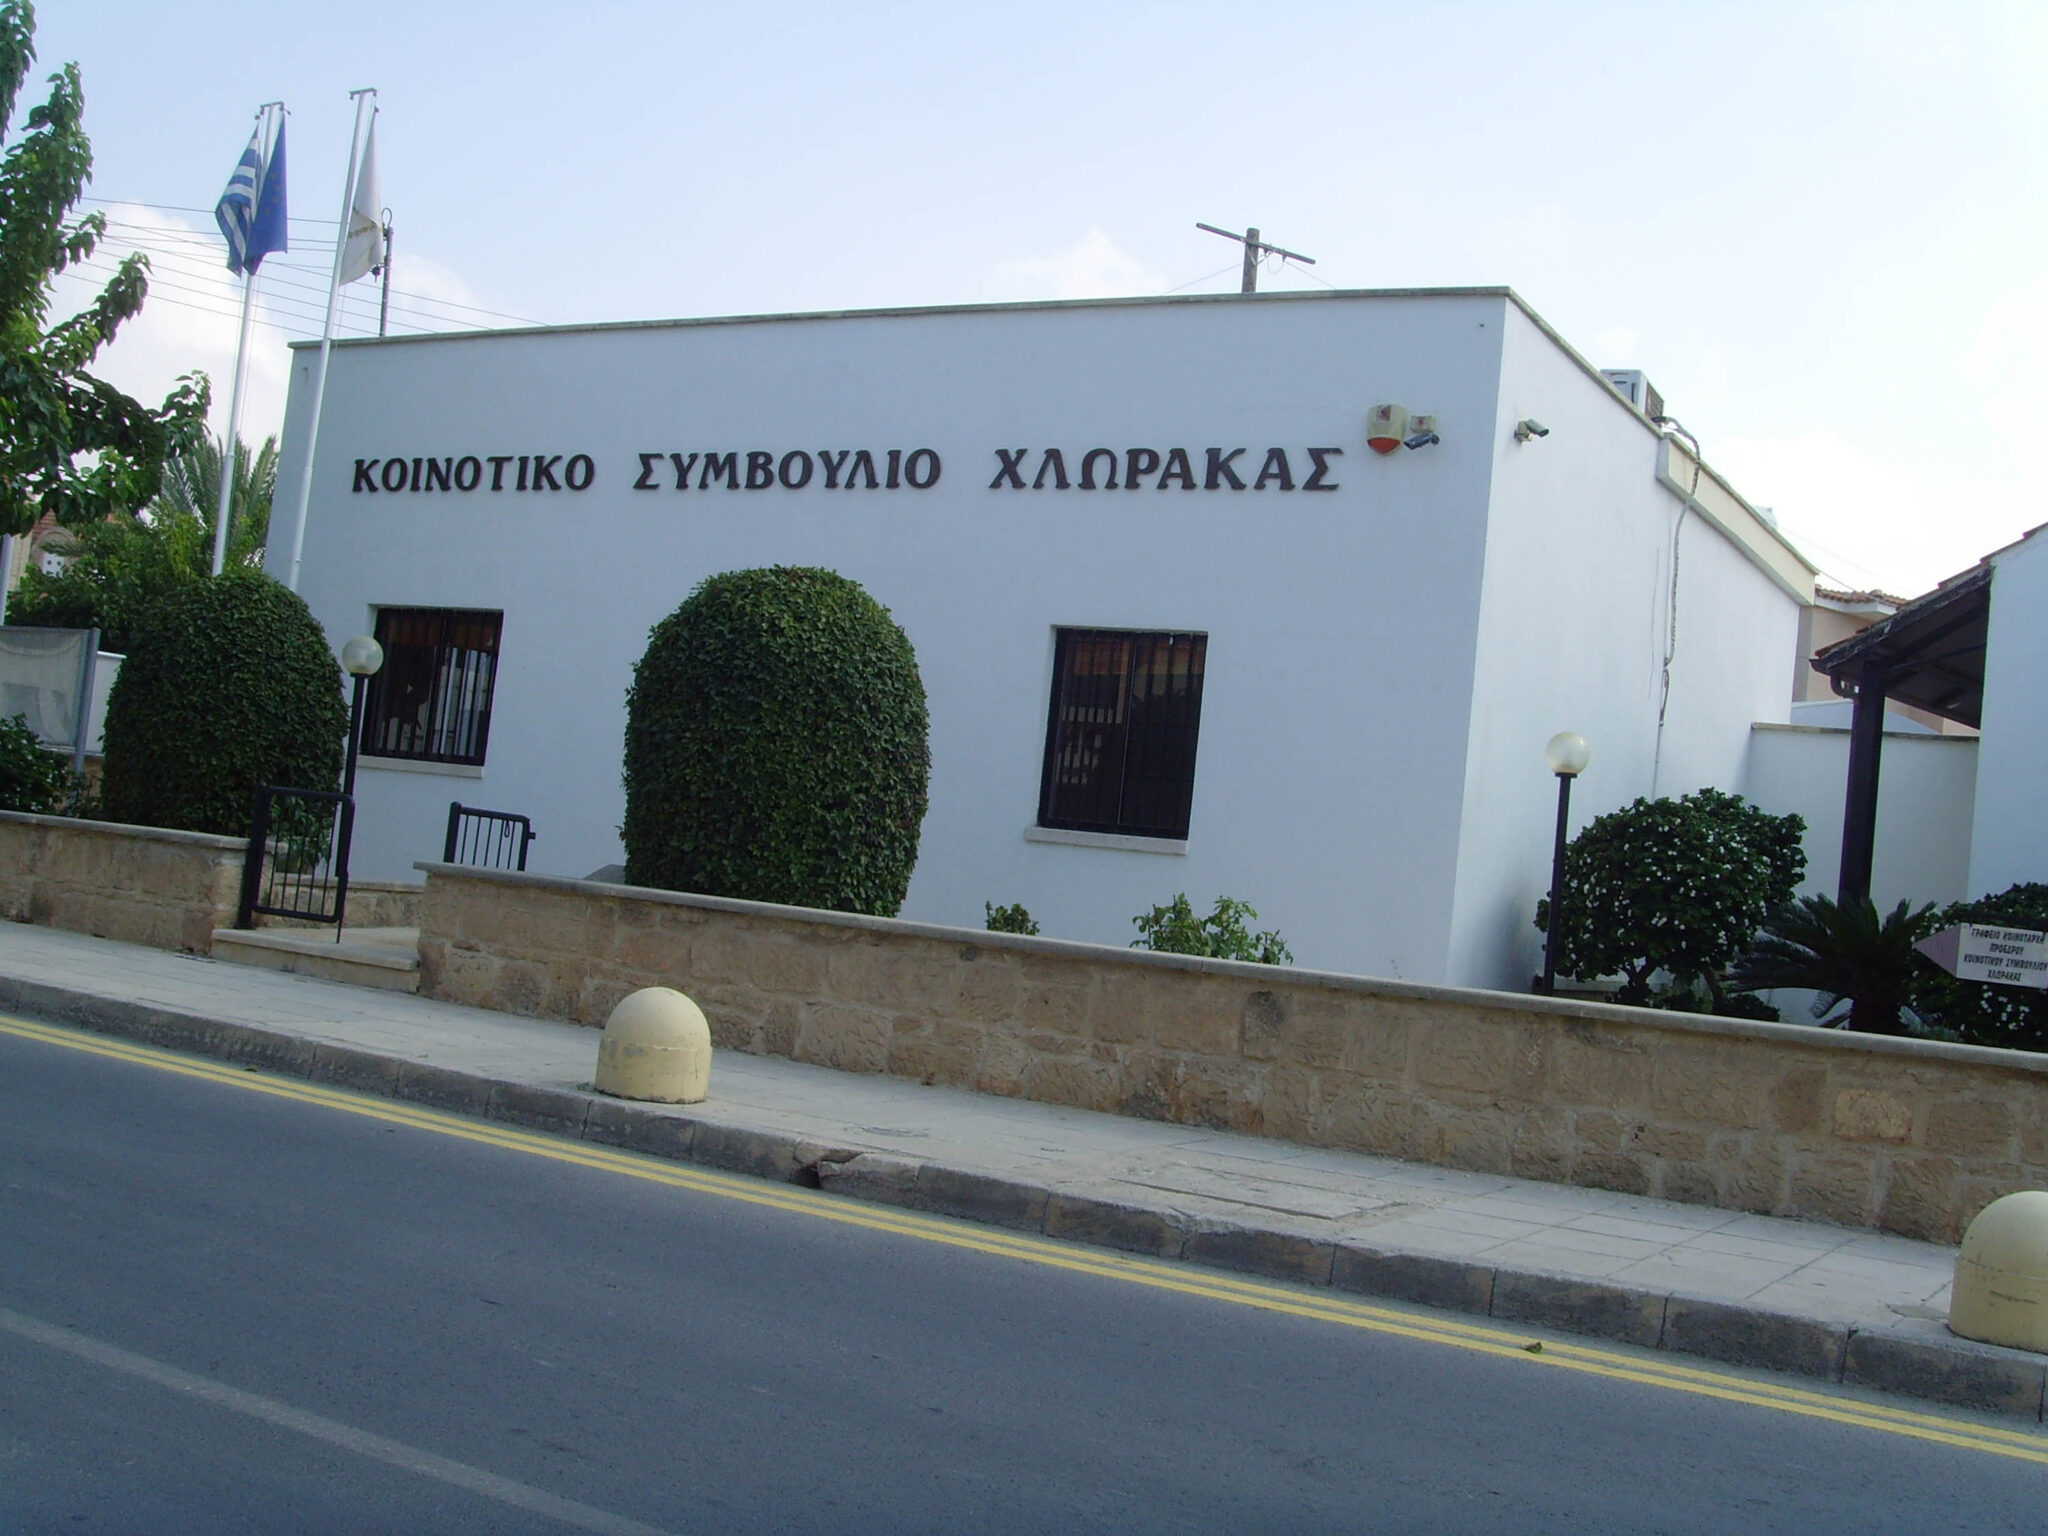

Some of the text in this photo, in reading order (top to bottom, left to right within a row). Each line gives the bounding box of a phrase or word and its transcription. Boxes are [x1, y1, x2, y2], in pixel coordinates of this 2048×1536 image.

[352, 447, 1344, 493] ΚΟΙΝΟΤΙΚΟ ΣΥΜΒΟΥΛΙΟ ΧΛΩΡΑΚΑΣ
[1971, 928, 2001, 940] ΓΡΑΦΕΙΟ
[1989, 943, 2024, 955] ΠΡΟΕΔΡΟΥ
[1963, 953, 2048, 971] ΚΟΙΝΟΤΙΚΟΥ ΣΥΜΒΟΥΛΙΟΥ
[1987, 968, 2022, 982] ΧΛΩΡΑΚΑΣ
